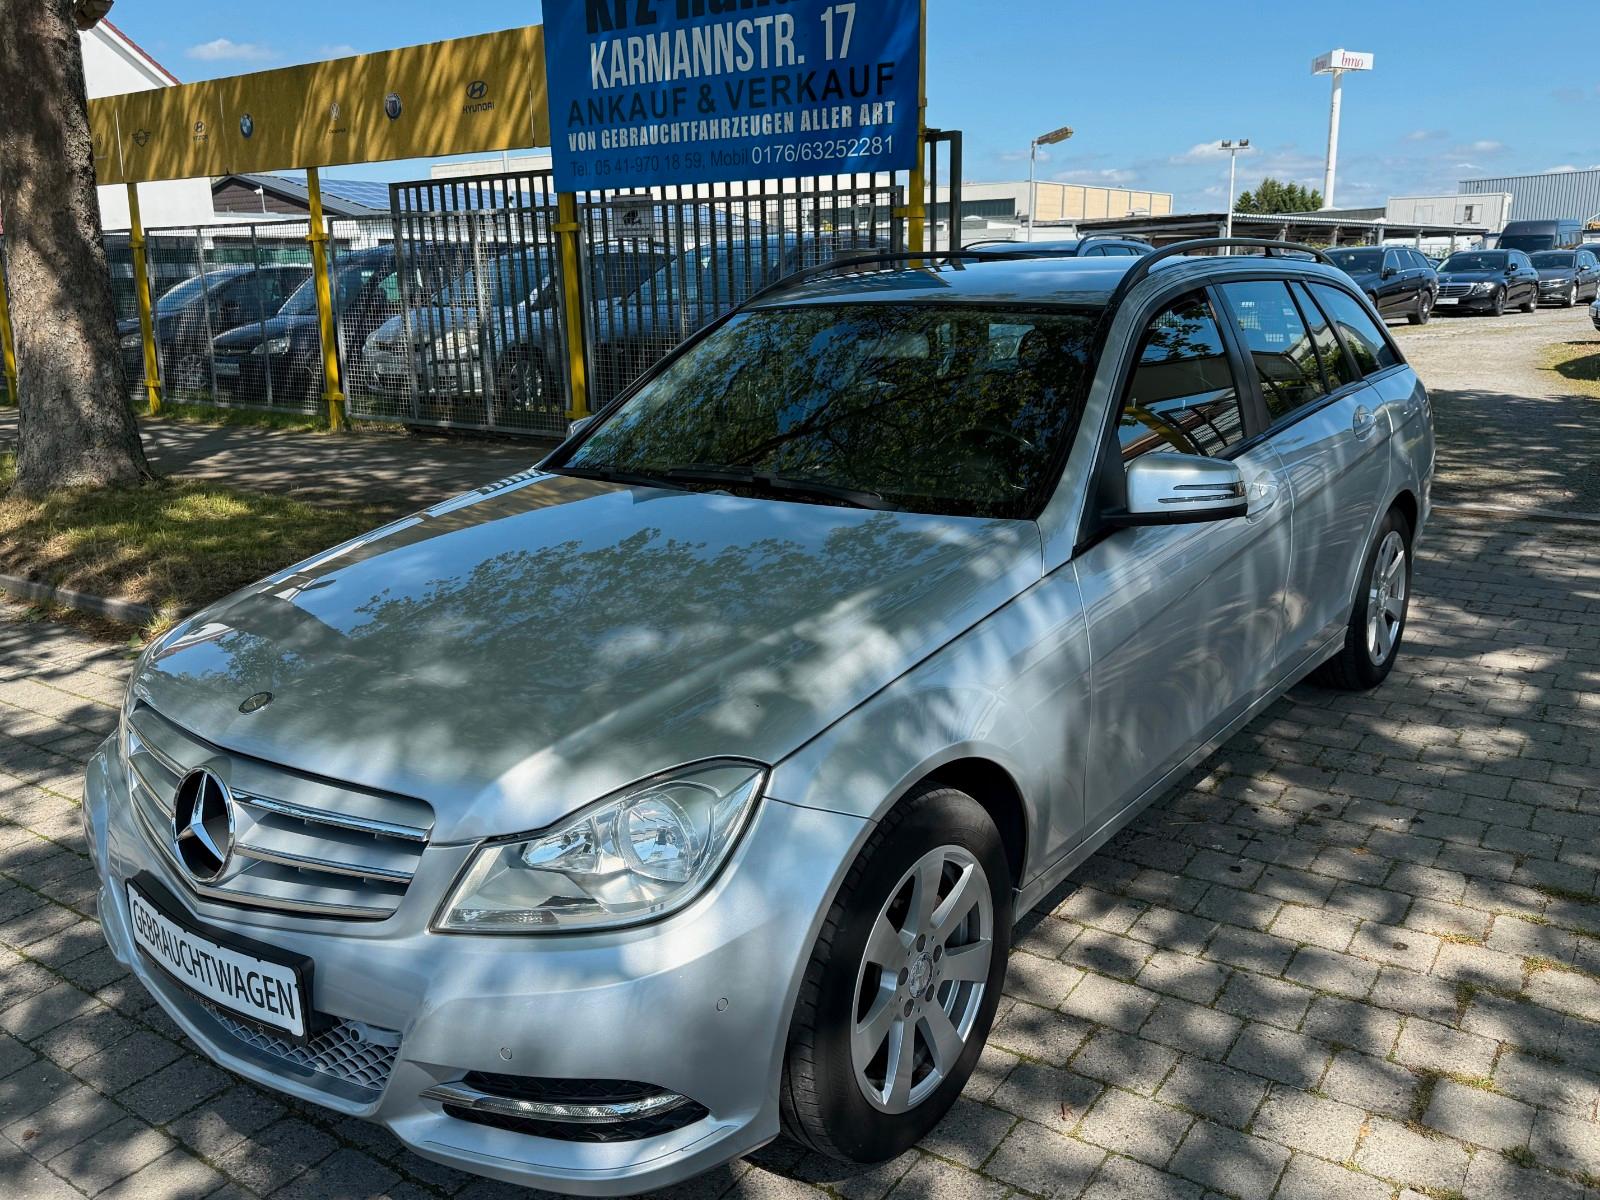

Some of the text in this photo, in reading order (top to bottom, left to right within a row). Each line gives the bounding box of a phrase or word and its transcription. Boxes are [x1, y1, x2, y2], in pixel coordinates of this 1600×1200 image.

[590, 13, 805, 90] KARMANNSTR.
[820, 2, 857, 61] 17
[462, 101, 495, 114] HYUNDAI
[568, 62, 895, 128] ANKAUF & VERKAUF
[568, 100, 895, 152] VON GEBRAUCHTFAHRZEUGEN ALLER ART
[663, 152, 681, 171] 18
[710, 147, 748, 168] Mobil
[752, 135, 892, 164] 0176/63252281
[133, 899, 296, 1020] GEBRAUCHTWAGEN
